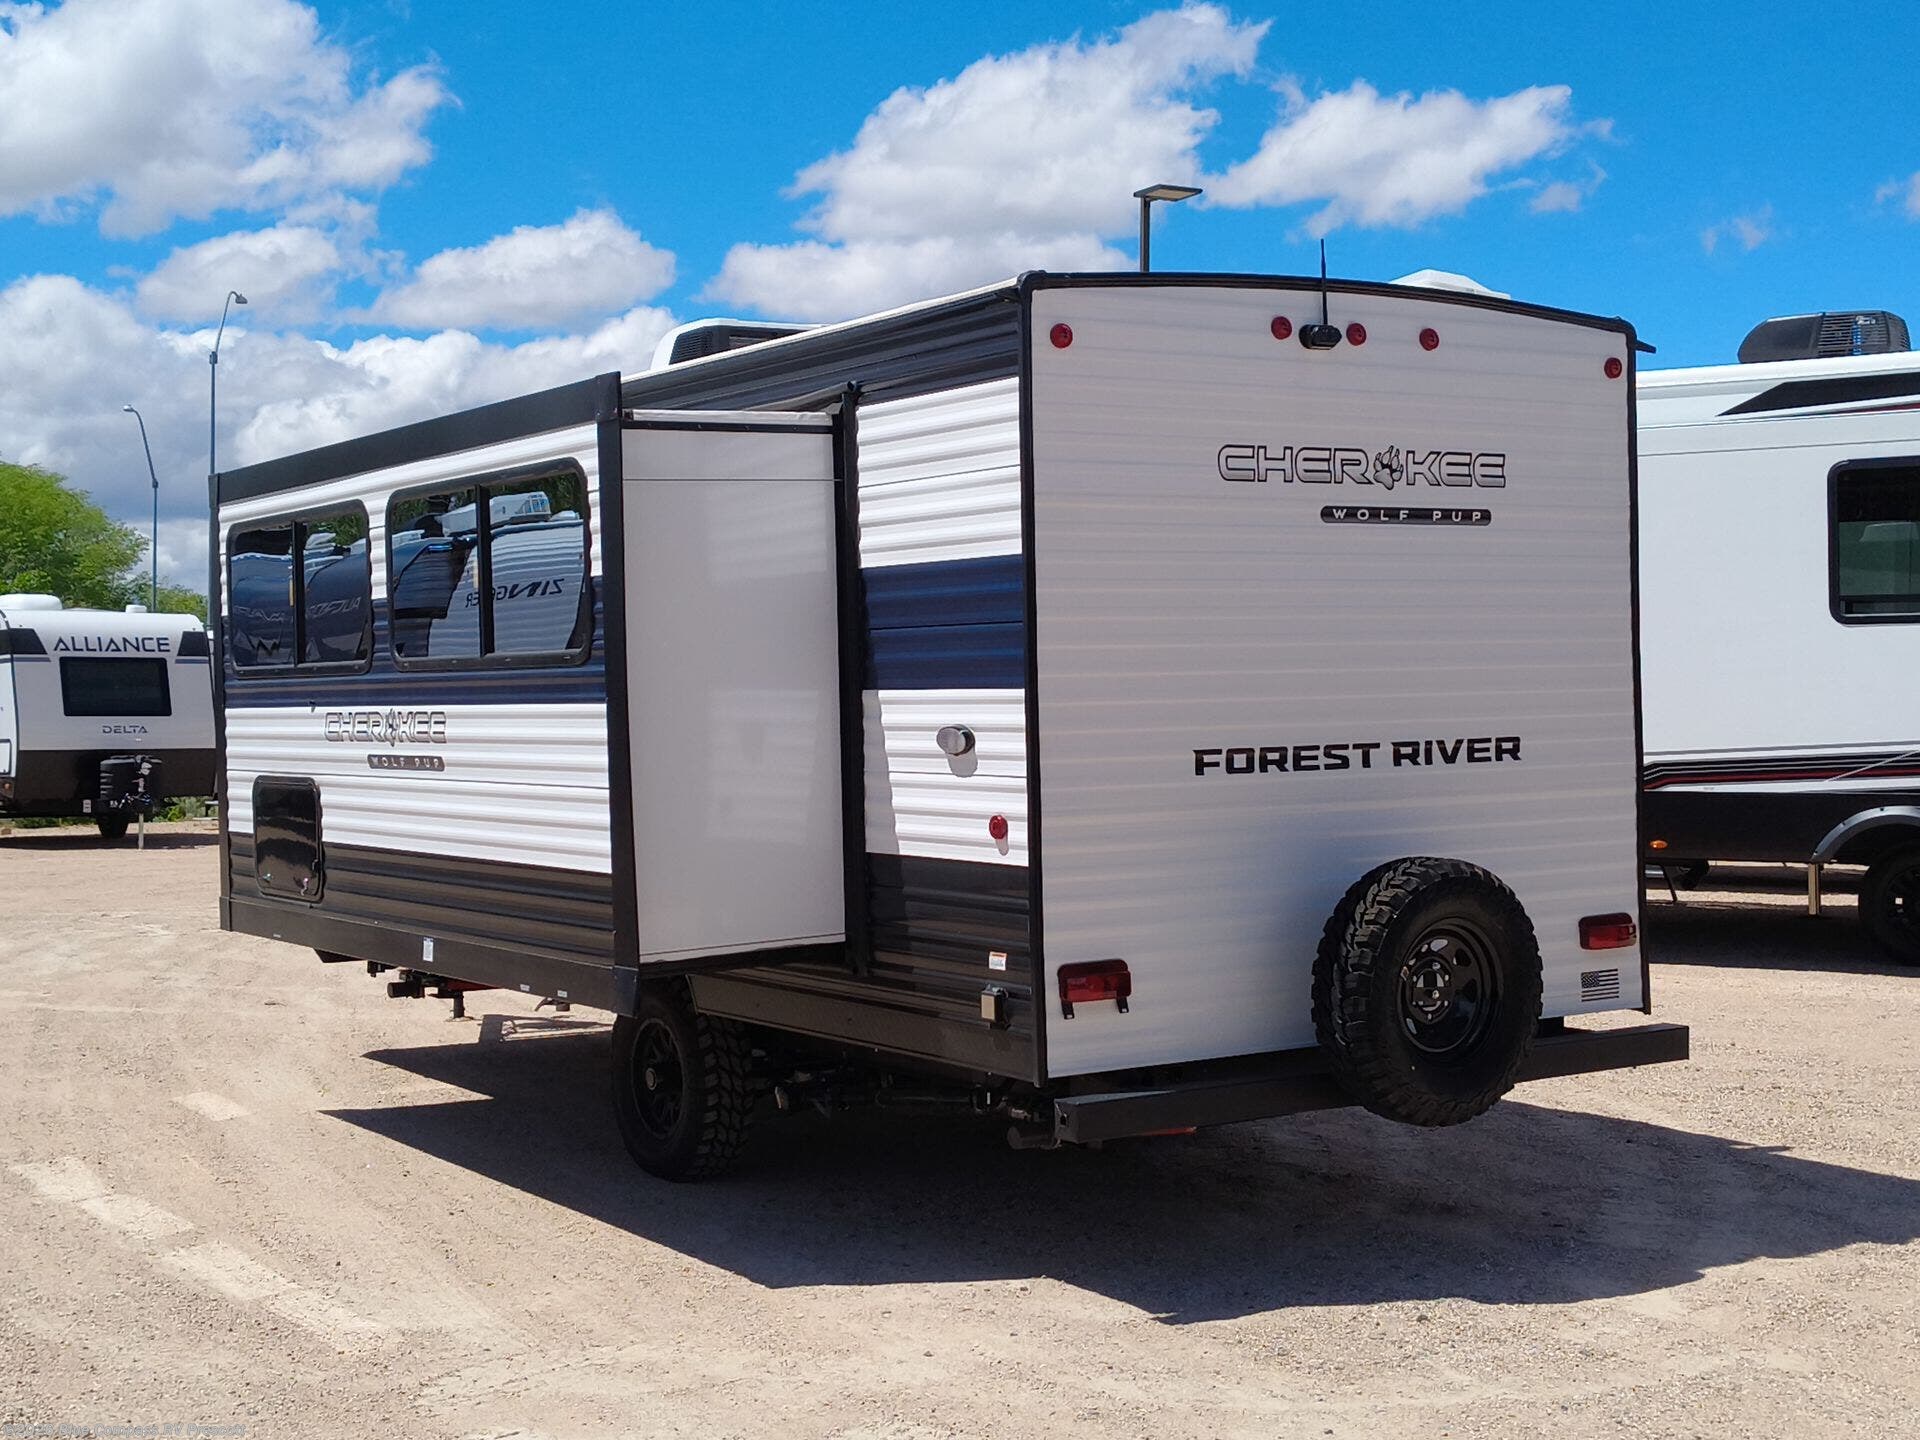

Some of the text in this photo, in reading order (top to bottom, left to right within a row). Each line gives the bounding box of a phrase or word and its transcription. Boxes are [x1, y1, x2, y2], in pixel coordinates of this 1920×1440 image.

[1332, 508, 1482, 523] WOLF PUP
[54, 636, 171, 653] ALLIANCE
[102, 725, 148, 734] DELTA
[371, 757, 439, 769] WOLF PUP
[1192, 736, 1522, 776] FOREST RIVER
